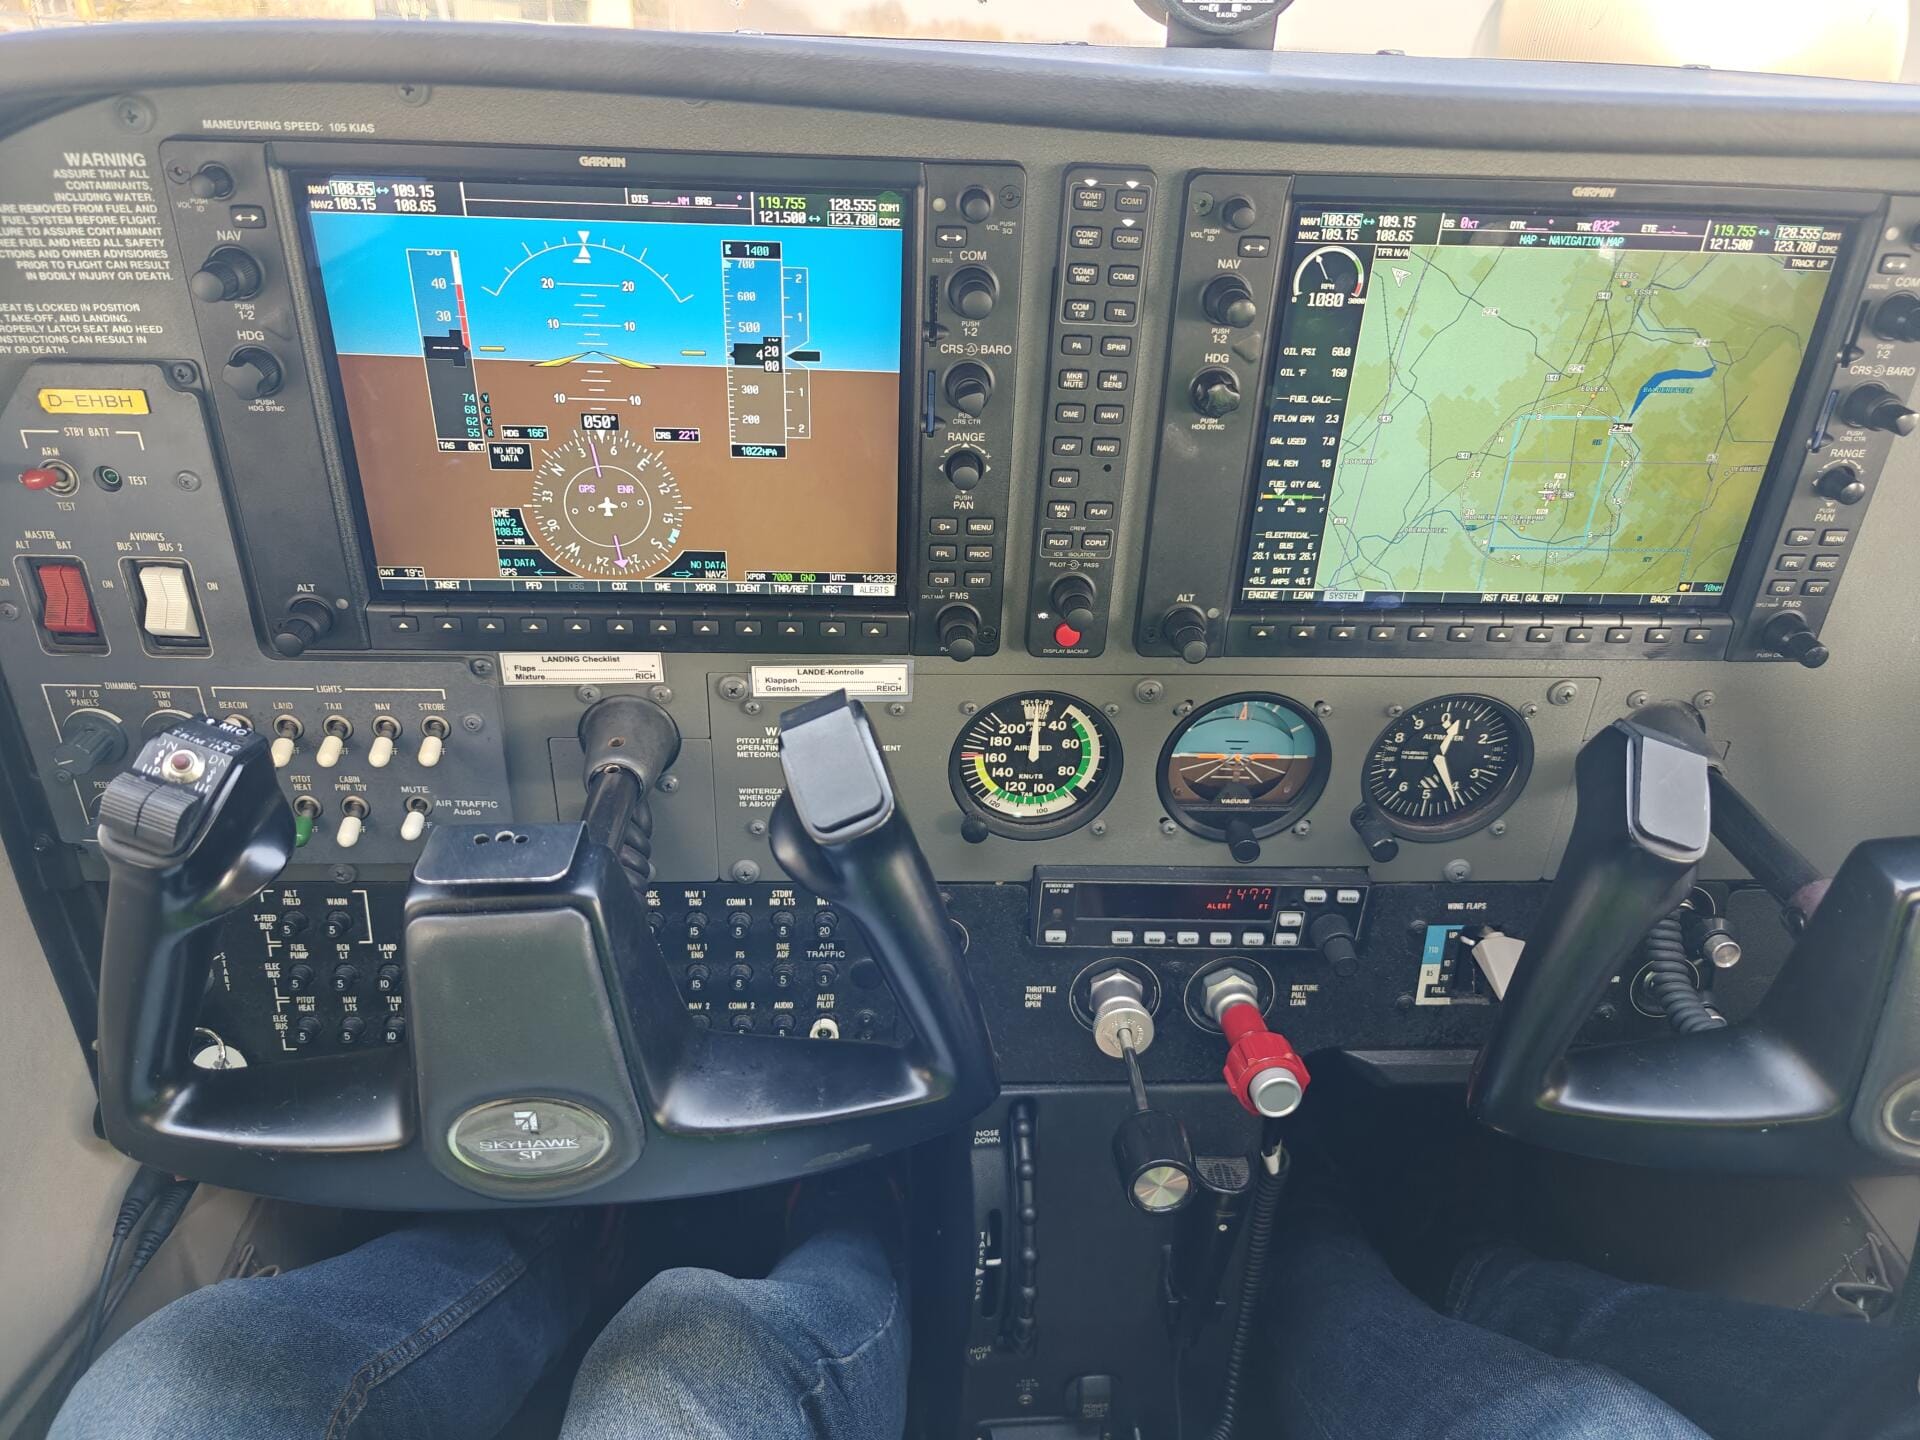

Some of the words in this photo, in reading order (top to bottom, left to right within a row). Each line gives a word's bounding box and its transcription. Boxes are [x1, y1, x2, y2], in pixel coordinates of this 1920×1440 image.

[202, 119, 282, 130] MANEUVERING
[283, 121, 324, 132] SPEED:
[328, 123, 347, 132] 105
[349, 123, 375, 133] KIAS
[64, 152, 147, 167] WARNING
[578, 156, 626, 168] GARMIN
[53, 170, 97, 179] ASSURE
[98, 170, 127, 179] THAT
[129, 170, 150, 179] ALL
[332, 182, 374, 196] 108.65
[392, 183, 435, 198] 109.15
[1572, 186, 1617, 198] GARMIN
[54, 192, 112, 202] INCLUDING
[1121, 197, 1142, 205] COM1
[335, 197, 377, 211] 109.15
[396, 199, 437, 213] 108.65
[759, 196, 806, 210] 119.755
[829, 198, 877, 212] 128.555
[2, 215, 29, 225] FUEL
[31, 215, 75, 225] SYSTEM
[77, 215, 118, 225] BEFORE
[759, 210, 806, 224] 121.500
[829, 212, 876, 226] 123.780
[1323, 214, 1360, 227] 108.65
[1378, 215, 1417, 228] 109.15
[217, 230, 242, 241] NAV
[1321, 229, 1358, 241] 109.15
[1375, 230, 1413, 242] 108.65
[1713, 224, 1758, 237] 119.755
[1777, 226, 1821, 239] 128.555
[1116, 235, 1138, 244] COM2
[1519, 235, 1537, 245] MAP
[1549, 235, 1602, 246] NAVIGATION
[1607, 237, 1625, 247] MAP
[1710, 238, 1753, 250] 121.500
[1774, 240, 1818, 253] 123.780
[959, 251, 987, 261] COM
[16, 260, 49, 270] PRIOR
[51, 260, 65, 270] TO
[67, 260, 104, 270] FLIGHT
[106, 260, 128, 270] CAN
[130, 260, 170, 270] RESULT
[1217, 259, 1241, 269] NAV
[1791, 259, 1814, 268] TRACK
[1817, 260, 1827, 268] UP
[26, 272, 37, 281] IN
[38, 272, 76, 281] BODILY
[78, 272, 115, 281] INJURY
[117, 272, 133, 281] OR
[135, 272, 174, 281] DEATH.
[1113, 273, 1135, 281] COM3
[540, 278, 555, 289] 20
[622, 281, 635, 292] 20
[737, 291, 756, 302] 600
[1307, 293, 1344, 307] 1080
[61, 314, 81, 323] AND
[83, 314, 130, 323] LANDING.
[738, 322, 760, 333] 500
[237, 330, 264, 341] HDG
[940, 344, 964, 354] CRS
[981, 345, 1012, 355] BARO
[1204, 353, 1230, 364] HDG
[741, 385, 759, 395] 300
[47, 394, 133, 408] D-EHBH
[63, 427, 85, 437] STBY
[89, 427, 110, 437] BATT
[467, 428, 480, 438] 55
[947, 433, 985, 441] RANGE
[41, 447, 60, 456] ARM
[1830, 449, 1866, 458] RANGE
[128, 476, 147, 485] TEST
[579, 485, 596, 494] GPS
[617, 485, 634, 494] ENR
[57, 502, 76, 511] TEST
[953, 501, 974, 510] PAN
[1814, 513, 1835, 522] PAN
[25, 531, 56, 540] MASTER
[130, 532, 165, 541] AVIONICS
[15, 540, 30, 549] ALT
[56, 540, 72, 549] BAT
[116, 542, 133, 551] BUS
[136, 542, 140, 551] 1
[159, 542, 175, 552] BUS
[178, 543, 183, 552] 2
[831, 574, 846, 582] UTC
[862, 574, 896, 583] 14:29:32
[296, 584, 315, 593] ALT
[435, 581, 460, 590] INSET
[526, 582, 543, 590] PFD
[612, 582, 628, 591] CDI
[654, 583, 671, 591] DME
[695, 583, 717, 592] XPDR
[735, 584, 761, 593] IDENT
[822, 585, 842, 594] NRST
[859, 585, 889, 594] ALERTS
[949, 592, 969, 600] FMS
[1248, 591, 1278, 600] ENGINE
[1293, 591, 1314, 600] LEAN
[1328, 592, 1358, 600] SYSTEM
[1650, 595, 1671, 604] BACK
[765, 677, 797, 685] Klappen
[316, 685, 343, 694] LIGHTS
[71, 699, 99, 707] PANELS
[374, 703, 390, 711] NAV
[418, 703, 446, 711] STROBE
[999, 724, 1025, 734] 200
[1048, 721, 1067, 731] 40
[1414, 719, 1424, 729] 9
[990, 736, 1012, 747] 180
[1395, 732, 1405, 743] 8
[1478, 734, 1488, 744] 2
[1062, 739, 1080, 749] 60
[985, 753, 1007, 763] 160
[992, 768, 1013, 777] 140
[1058, 767, 1075, 776] 80
[1388, 769, 1397, 778] 7
[1470, 769, 1480, 778] 3
[1005, 782, 1026, 791] 120
[1034, 783, 1055, 793] 100
[1399, 782, 1408, 791] 6
[1422, 789, 1431, 798] 5
[435, 800, 452, 808] AIR
[454, 800, 498, 808] TRAFFIC
[453, 808, 481, 816] Audio
[1448, 902, 1463, 910] WING
[1466, 902, 1487, 910] FLAPS
[975, 1129, 1000, 1137] NOSE
[479, 1138, 580, 1149] SKYHAWK
[974, 1136, 1000, 1144] DOWN
[519, 1151, 542, 1160] SP
